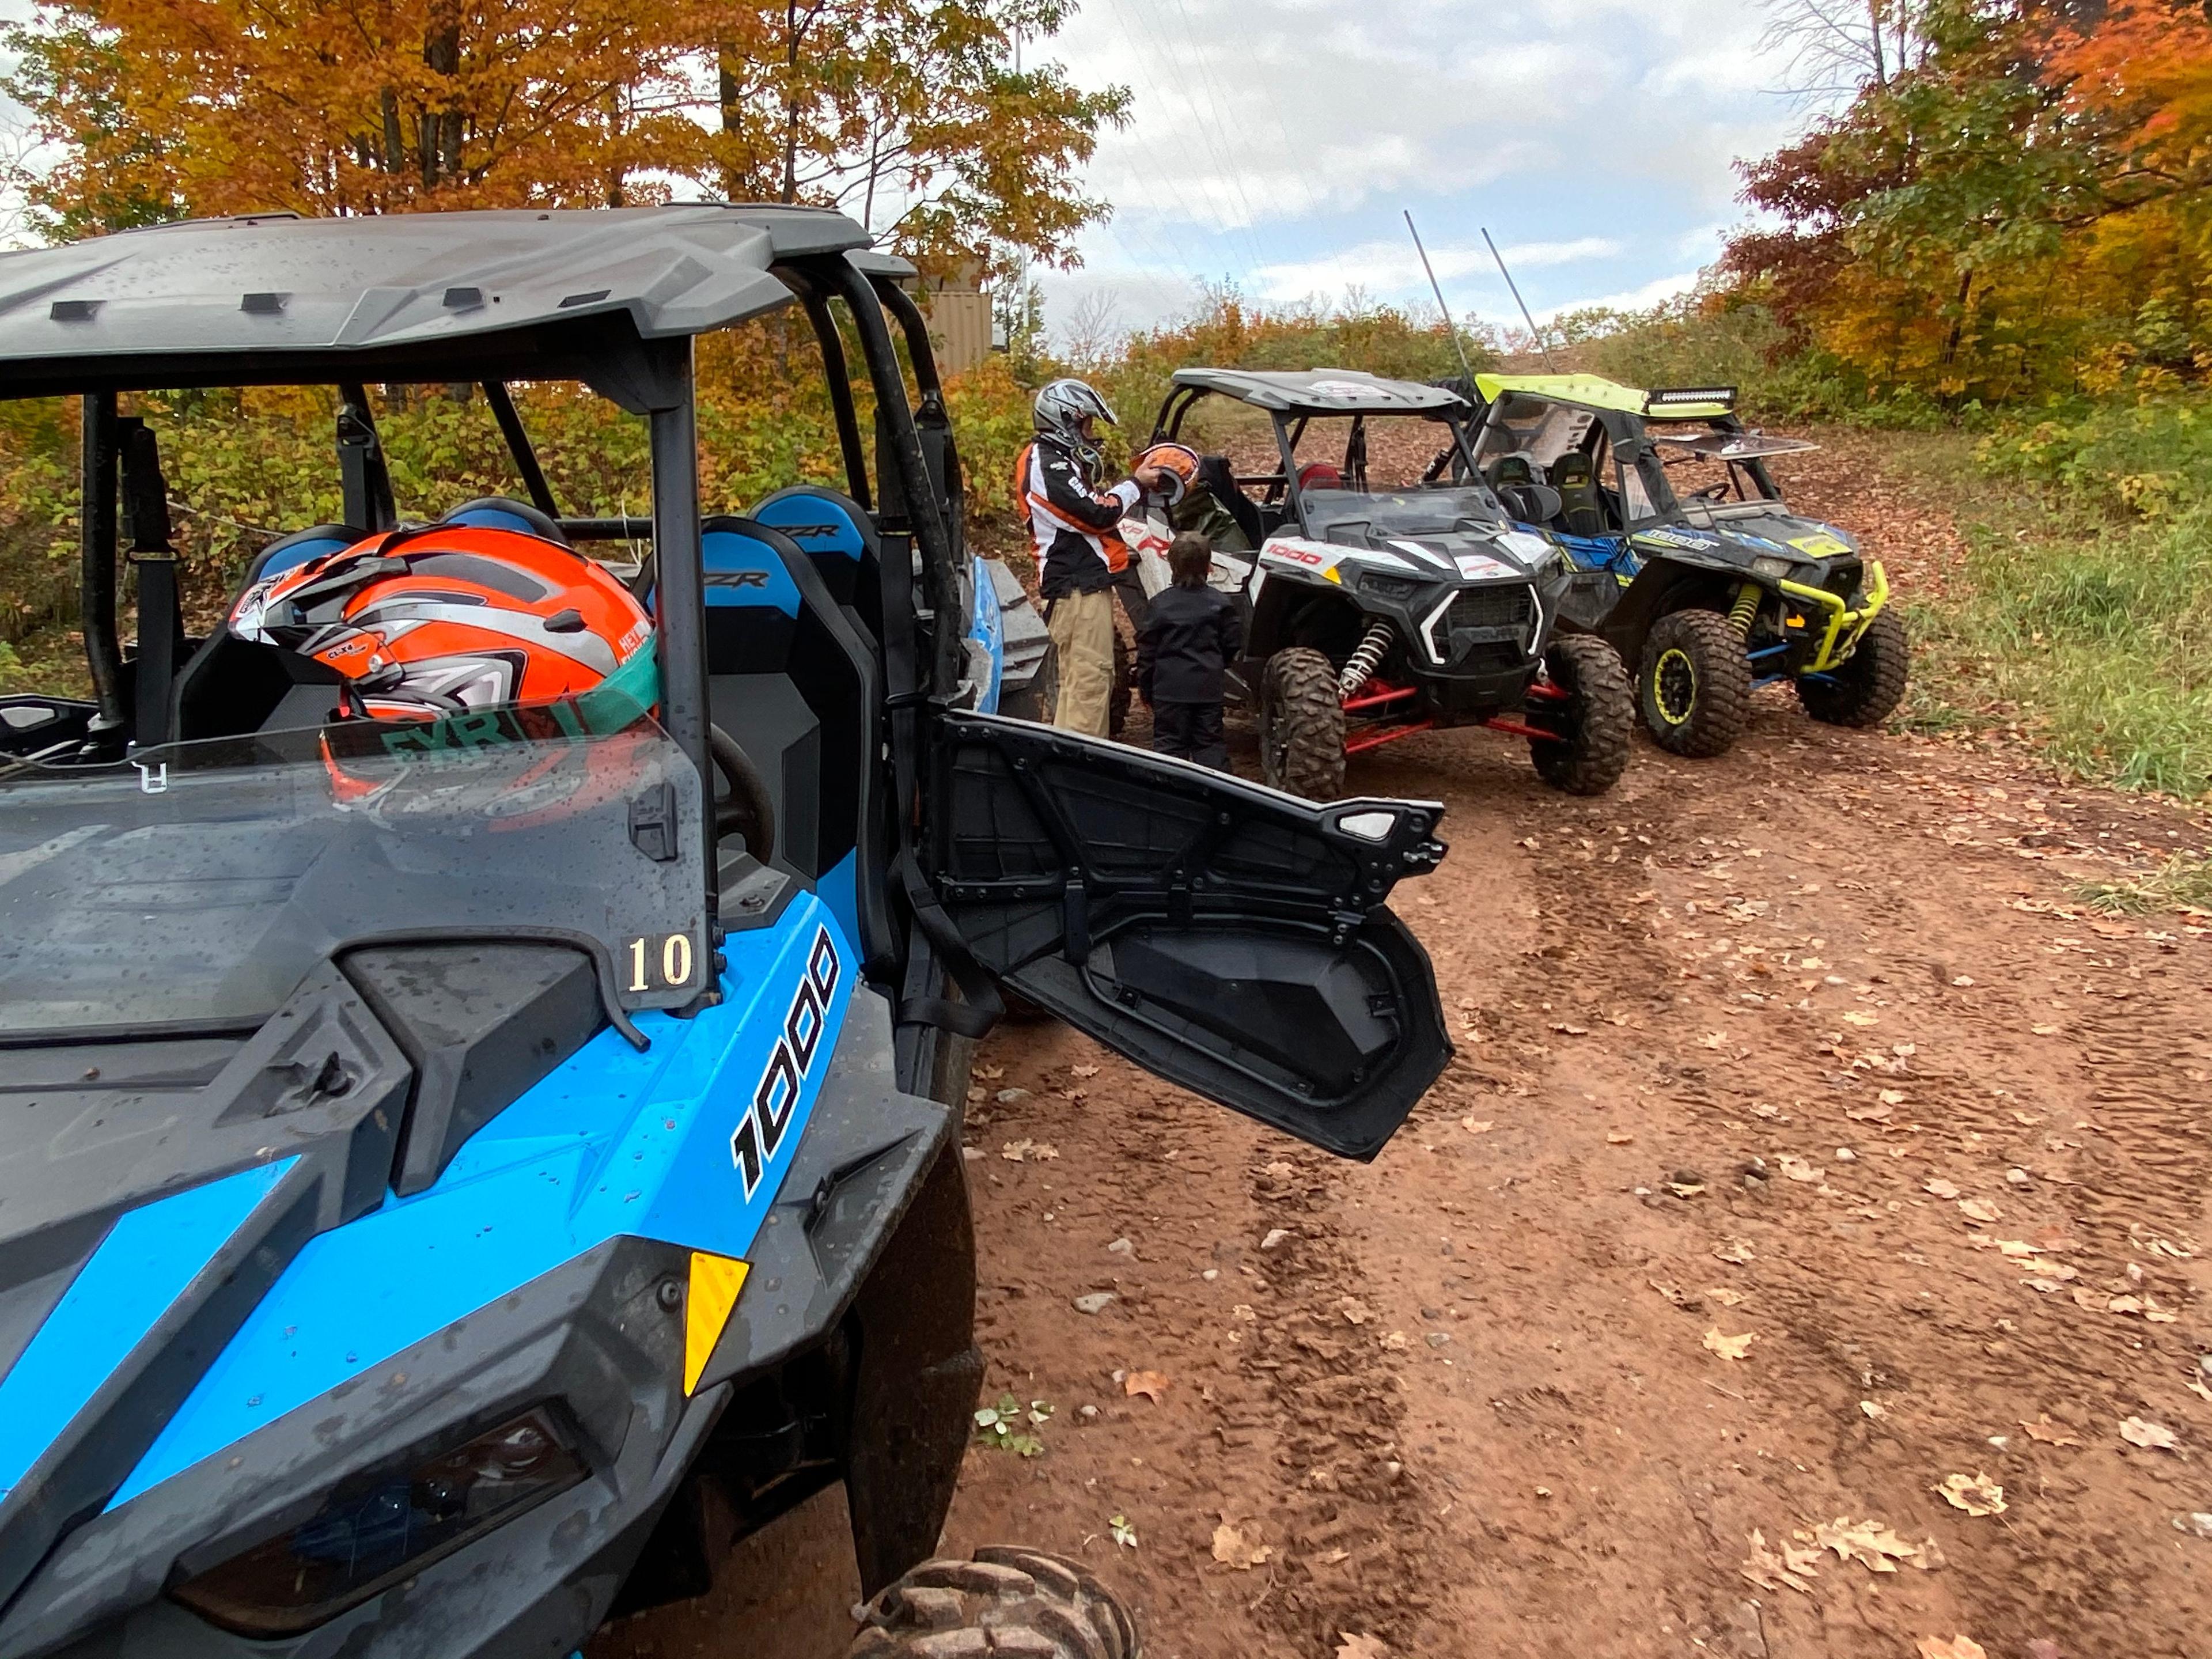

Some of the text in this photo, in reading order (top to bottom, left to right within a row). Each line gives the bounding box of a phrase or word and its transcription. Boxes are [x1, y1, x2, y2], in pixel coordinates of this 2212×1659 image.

[1646, 529, 1710, 551] 1000
[1266, 543, 1323, 565] 1000
[703, 571, 770, 588] ZR
[629, 934, 692, 991] 10
[730, 922, 841, 1205] 1000
